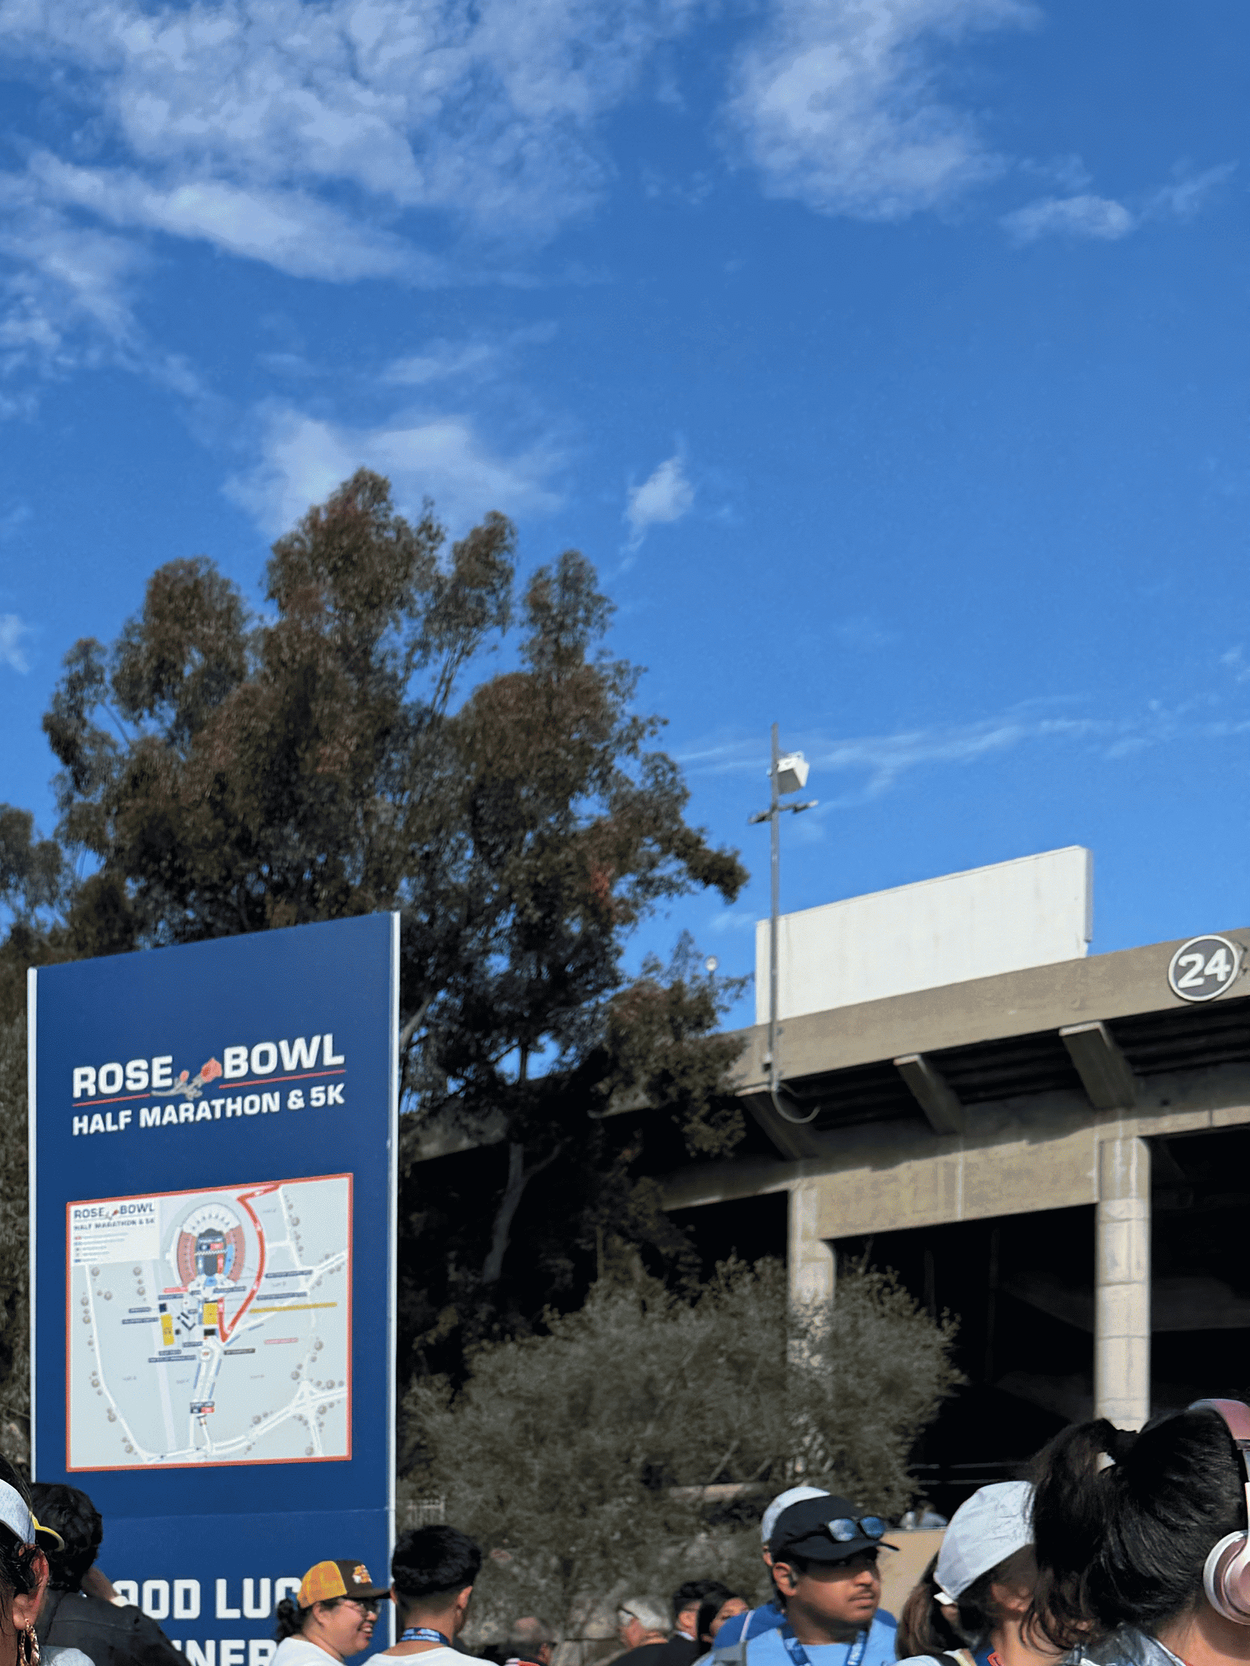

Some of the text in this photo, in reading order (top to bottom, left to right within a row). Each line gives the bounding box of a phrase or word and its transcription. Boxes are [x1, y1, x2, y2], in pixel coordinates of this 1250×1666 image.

[1177, 948, 1231, 988] 24
[72, 1033, 345, 1098] ROSE BOWL
[72, 1083, 346, 1136] HALF MARATHON & 5K
[73, 1203, 155, 1219] ROSE BOWL
